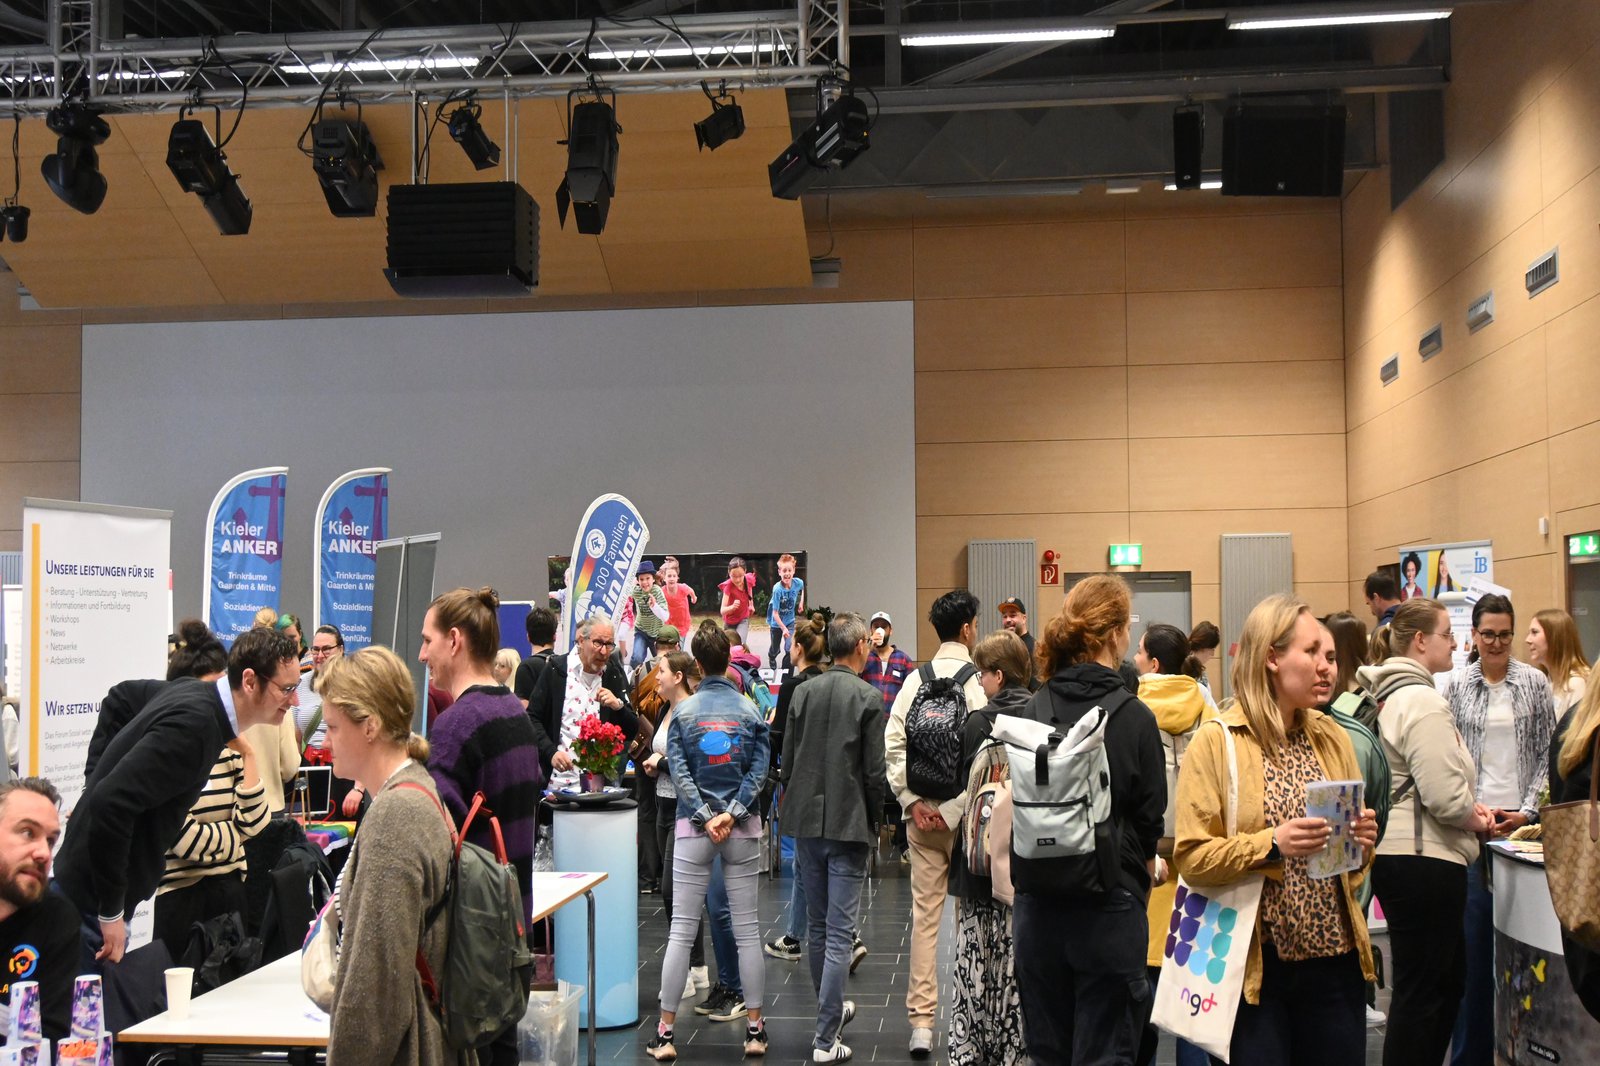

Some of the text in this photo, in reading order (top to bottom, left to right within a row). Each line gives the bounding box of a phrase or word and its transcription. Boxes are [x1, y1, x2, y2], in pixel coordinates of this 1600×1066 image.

[221, 521, 264, 536] Kieler
[328, 521, 369, 536] Kieler
[221, 539, 278, 555] ANKER
[595, 567, 610, 589] 100
[604, 514, 629, 566] Familien
[602, 579, 621, 613] in
[613, 521, 641, 579] Not
[228, 571, 268, 581] Trinkräume
[335, 571, 375, 581] Trinkräume
[218, 581, 276, 592] Gaarden & Mitte
[327, 581, 357, 590] Gaarden
[358, 582, 364, 590] &
[50, 586, 75, 598] Beratung
[79, 588, 117, 599] Unterstützung
[121, 589, 148, 600] Vertretung
[50, 601, 131, 612] Informationen und Fortbildung
[50, 615, 80, 624] Workshops
[231, 623, 251, 632] Sozia
[341, 623, 367, 632] Soziale
[50, 629, 66, 637] News
[216, 632, 236, 641] Straß
[50, 643, 78, 651] Netzwerke
[50, 656, 86, 665] Arbeitskreise
[758, 667, 790, 685] er
